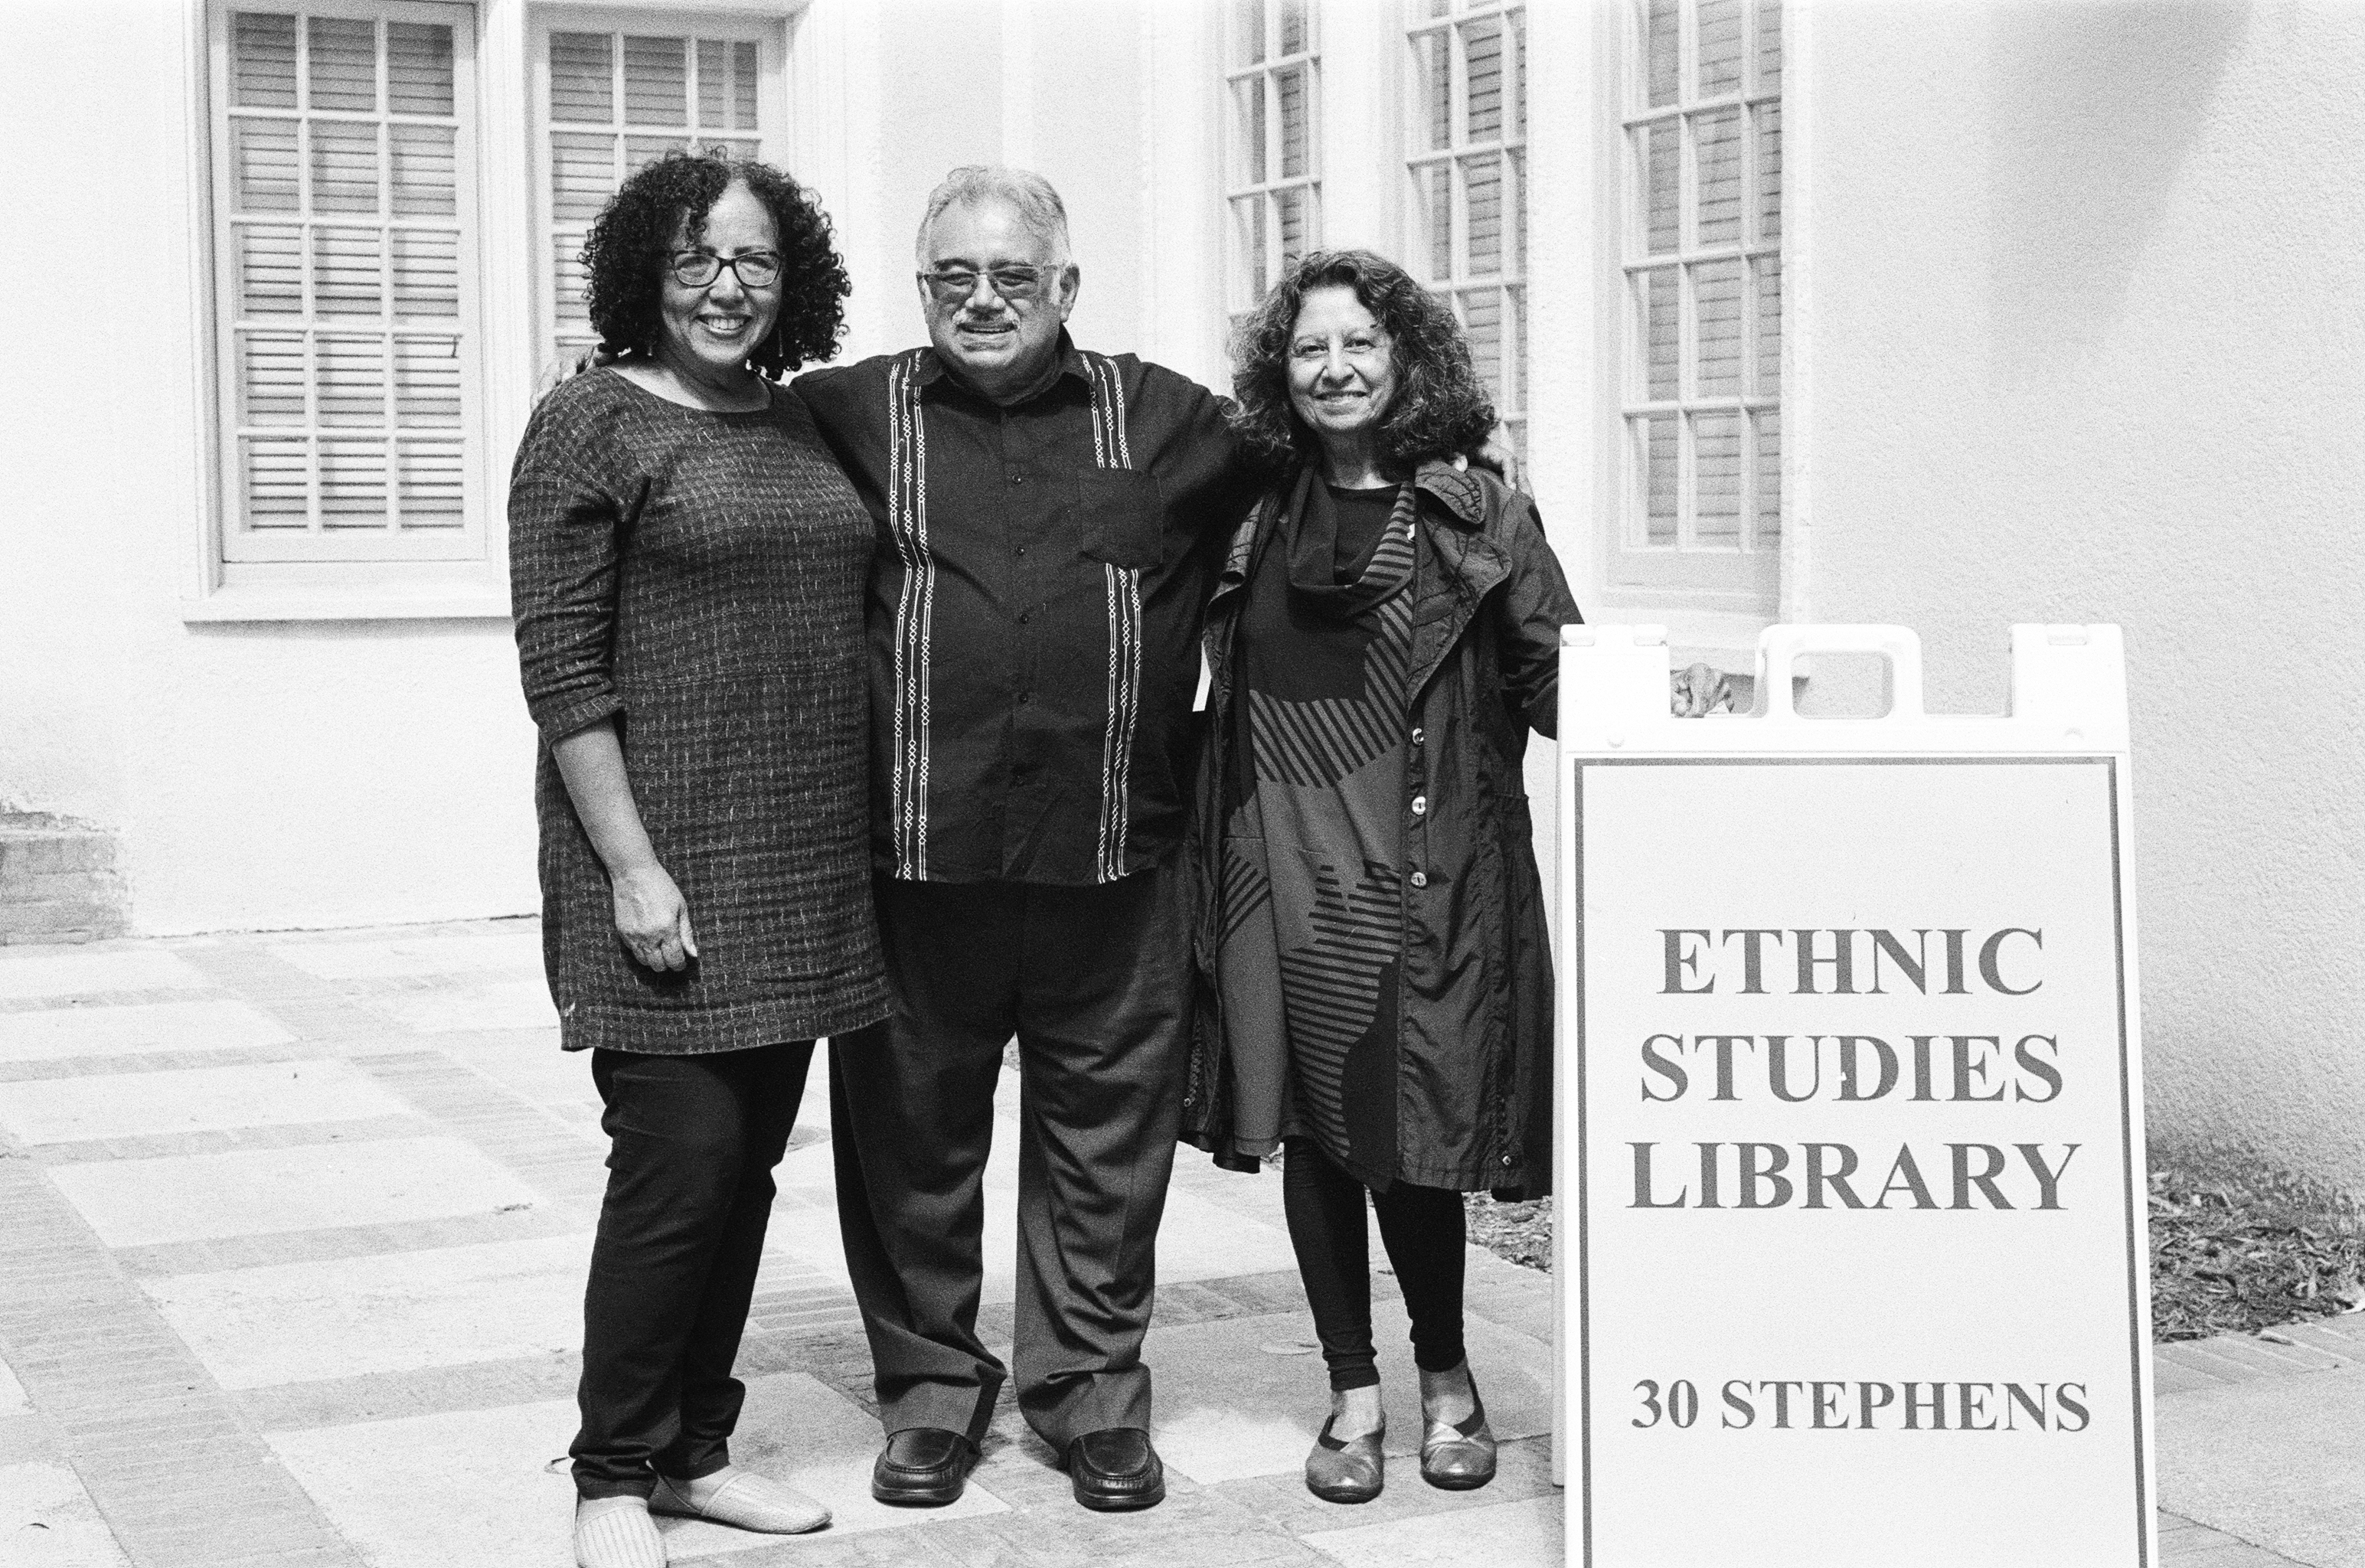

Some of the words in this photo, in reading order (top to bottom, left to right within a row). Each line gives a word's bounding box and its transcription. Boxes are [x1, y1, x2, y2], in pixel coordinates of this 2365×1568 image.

[1655, 927, 2043, 996] ETHNIC
[1640, 1034, 2063, 1103] STUDIES
[1625, 1142, 2082, 1210] LIBRARY
[1632, 1379, 1699, 1429] 30
[1721, 1380, 2091, 1432] STEPHENS
